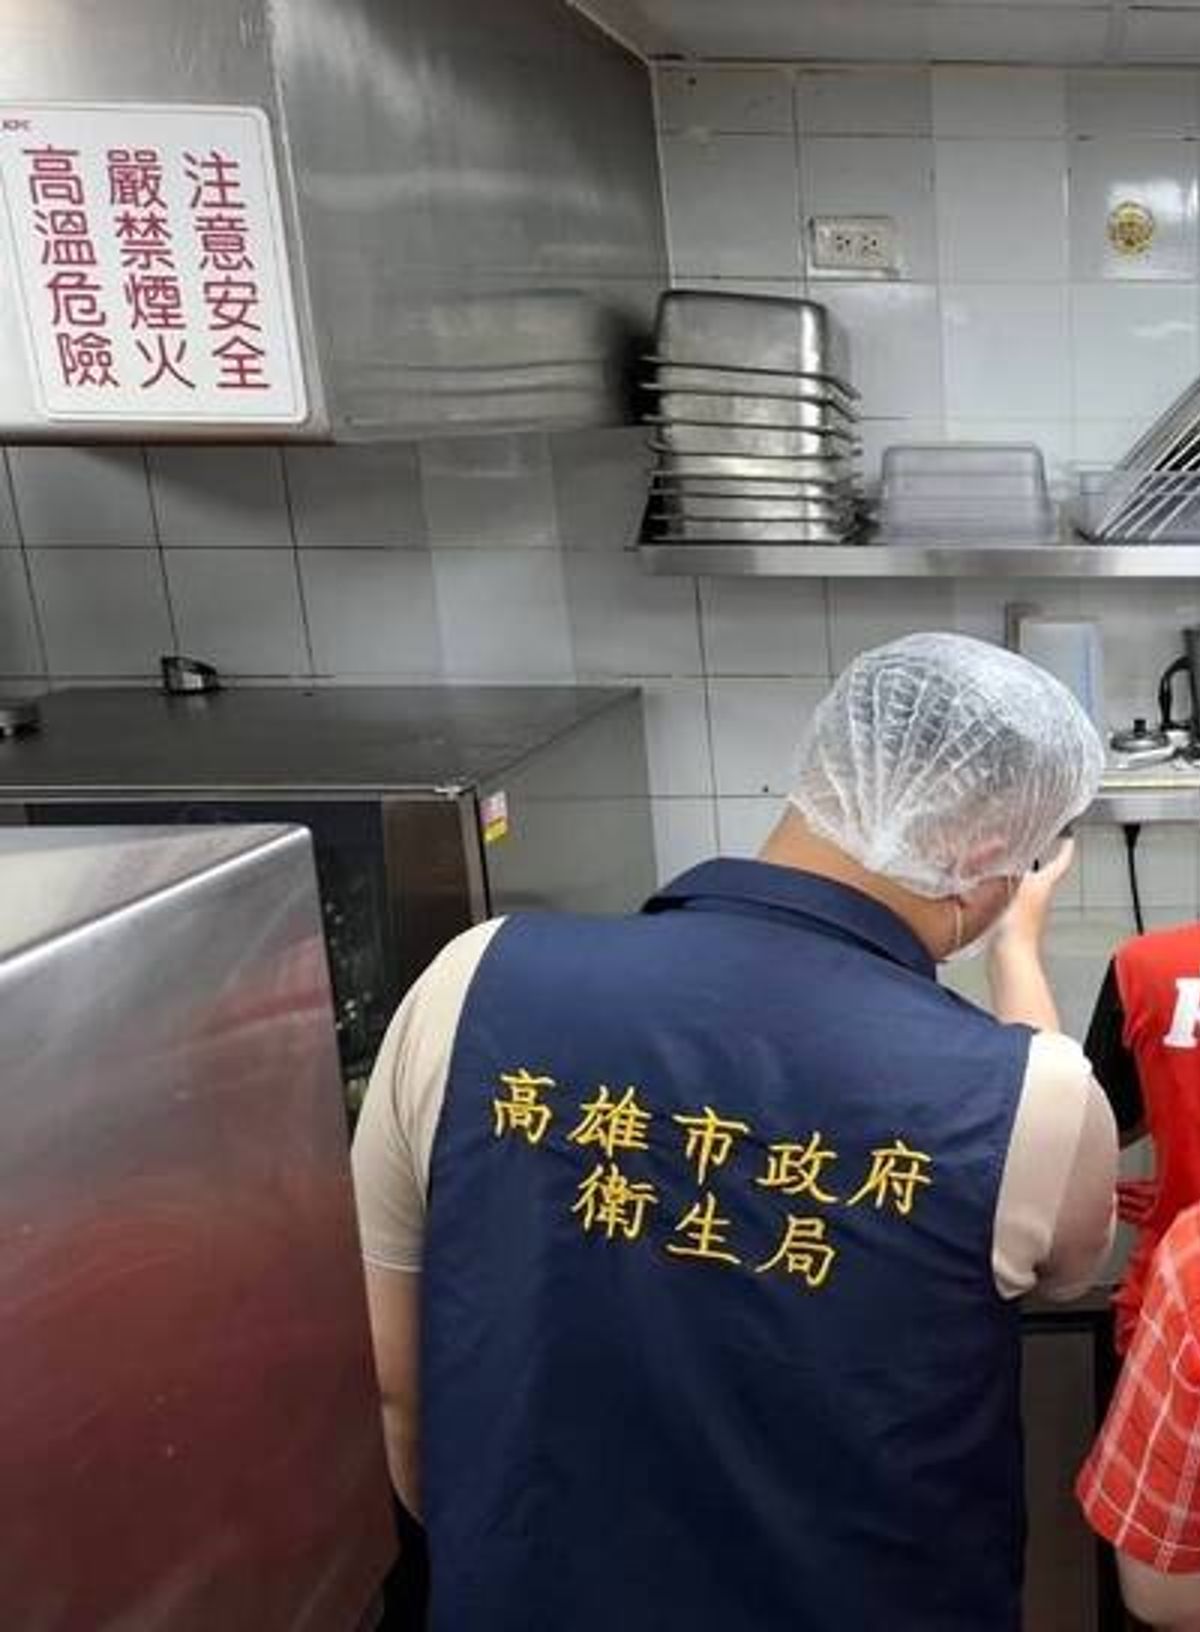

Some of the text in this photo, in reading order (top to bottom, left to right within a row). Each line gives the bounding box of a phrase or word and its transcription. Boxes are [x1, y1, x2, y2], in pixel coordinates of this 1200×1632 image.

[22, 144, 119, 388] 高溫危險
[106, 149, 196, 389] 嚴禁煙火
[182, 151, 270, 389] 注意安全
[493, 1068, 934, 1216] 高雄市政府
[570, 1163, 836, 1286] 衛生局
